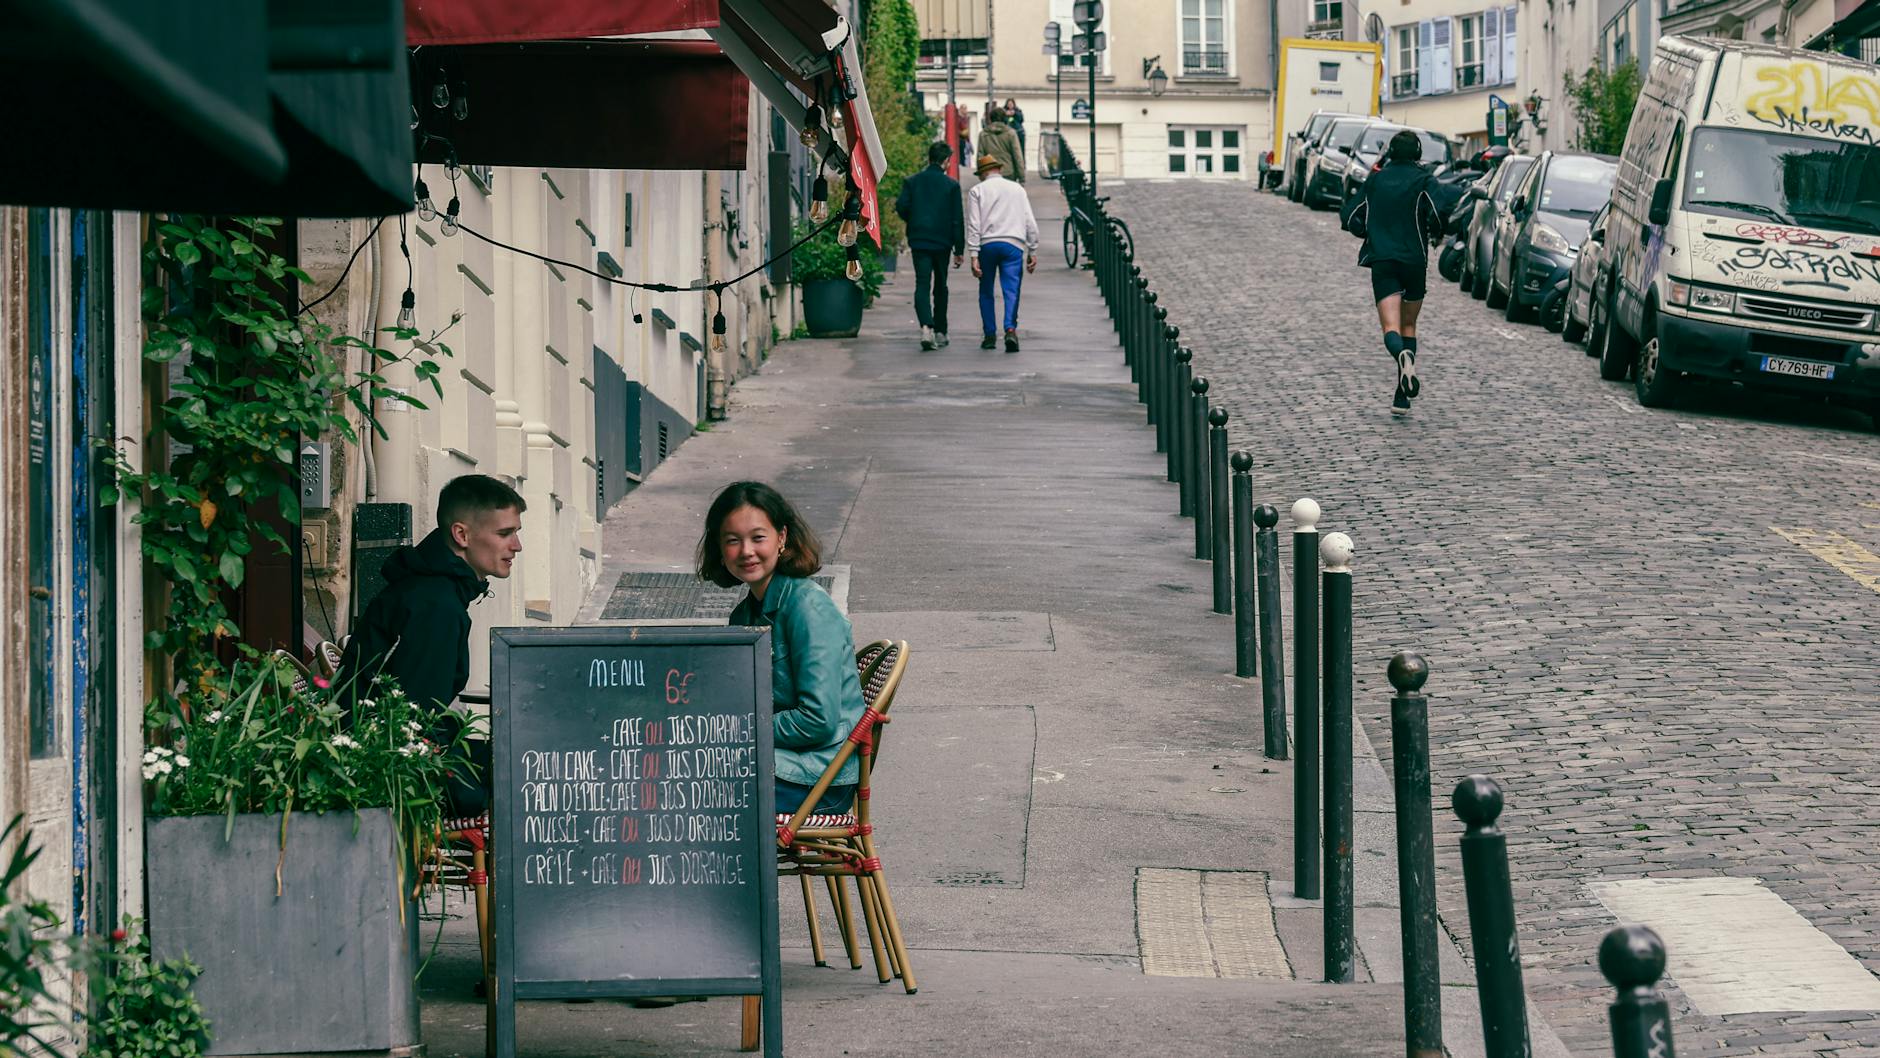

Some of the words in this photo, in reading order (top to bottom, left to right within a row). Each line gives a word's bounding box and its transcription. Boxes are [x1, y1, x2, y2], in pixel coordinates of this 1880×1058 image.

[1788, 307, 1821, 319] IVECO
[589, 659, 645, 688] MENU
[666, 669, 695, 704] 6€
[613, 717, 643, 746] CAFE
[645, 721, 664, 746] OU
[667, 715, 694, 745] JUS
[522, 750, 560, 780] PAIN
[611, 748, 642, 780] CAFE
[643, 752, 660, 779] OU
[666, 749, 691, 779] JUS
[521, 782, 558, 812] PAIN
[641, 781, 657, 810] OU
[660, 780, 686, 810] JUS
[593, 815, 617, 843] CAFE
[622, 815, 639, 842] OU
[645, 814, 672, 842] JUS
[623, 857, 641, 884] OU
[648, 854, 675, 885] JUS
